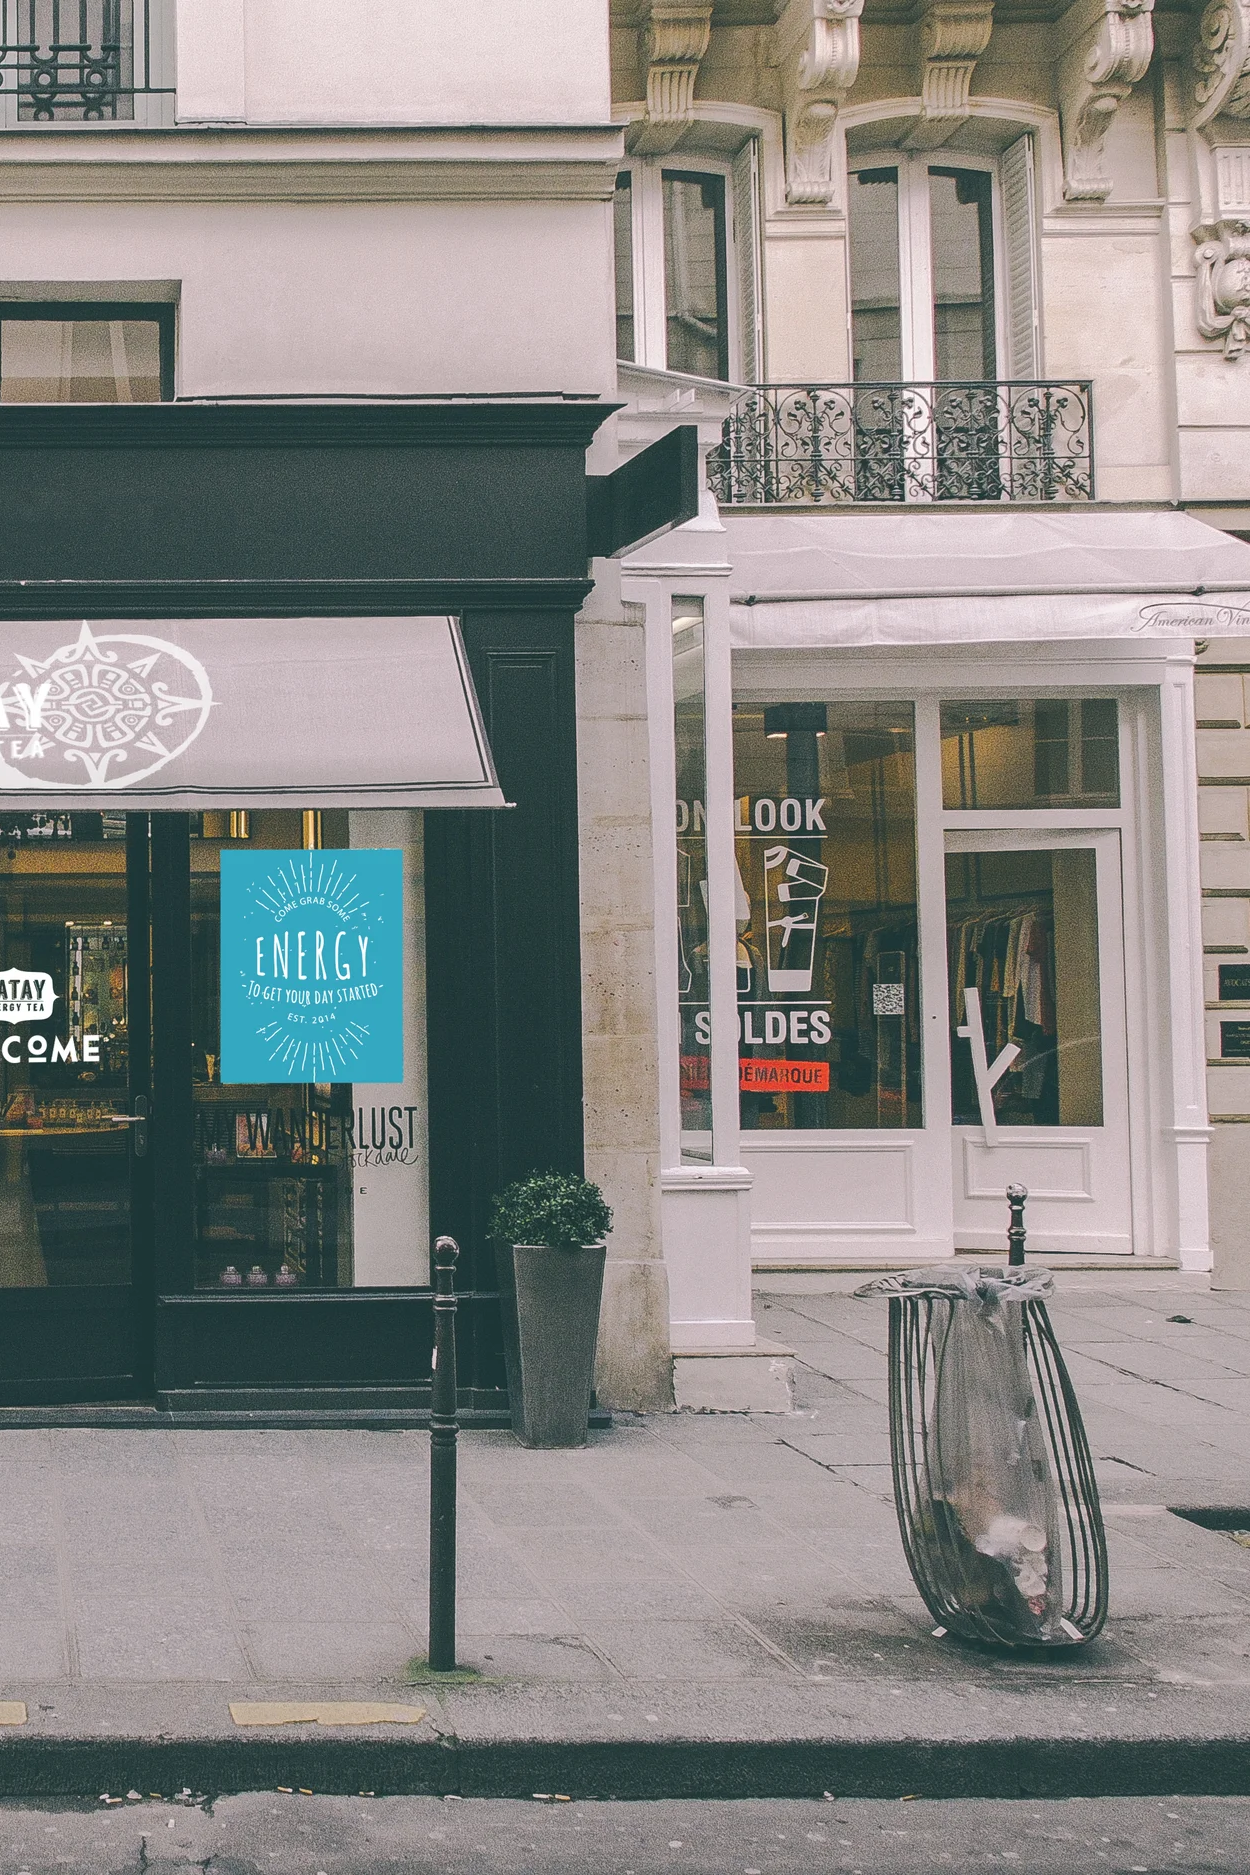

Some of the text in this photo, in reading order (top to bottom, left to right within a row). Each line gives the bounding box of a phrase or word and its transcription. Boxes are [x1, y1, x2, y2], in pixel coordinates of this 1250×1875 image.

[1130, 603, 1214, 632] American
[734, 798, 827, 831] LOOK
[274, 896, 351, 923] COME GRAB SOME
[256, 931, 368, 980] ENERGY
[249, 980, 379, 1005] TO GET YOUR DAY STARTED
[27, 1003, 45, 1012] TEA
[288, 1012, 336, 1024] EST. 2014
[695, 1010, 832, 1044] SLDES
[739, 1062, 822, 1084] ÉMARQUE
[245, 1106, 417, 1149] WANDERLUST
